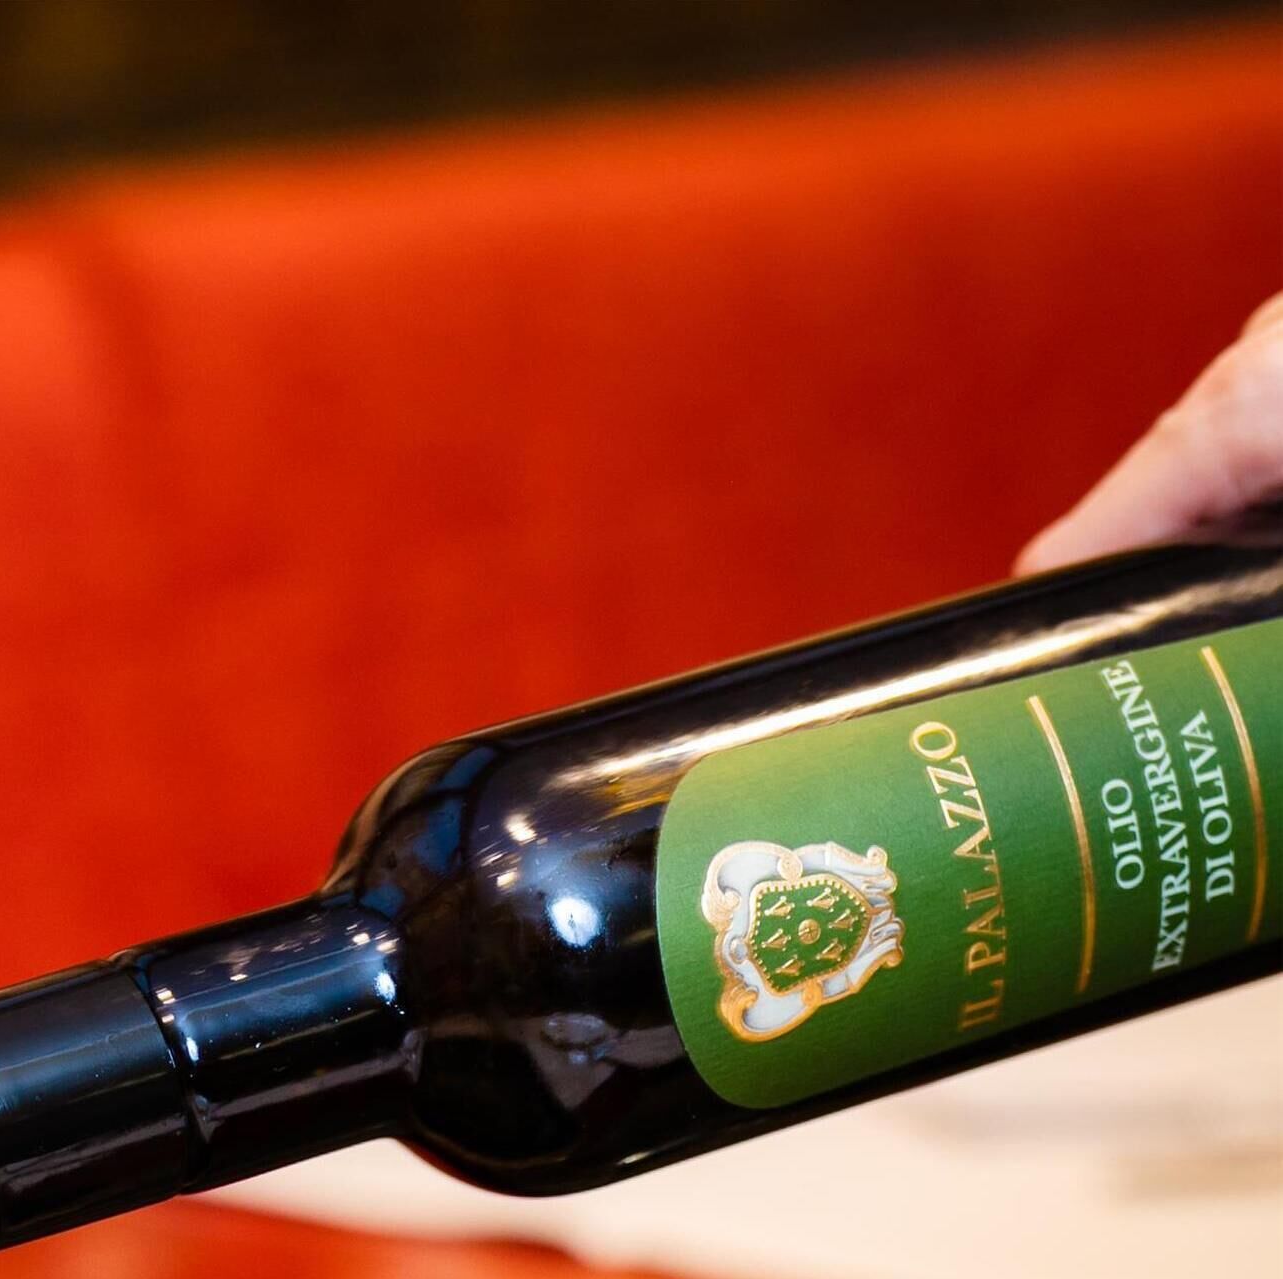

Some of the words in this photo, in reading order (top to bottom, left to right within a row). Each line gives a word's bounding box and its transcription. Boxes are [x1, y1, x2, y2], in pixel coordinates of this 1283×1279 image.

[1101, 660, 1190, 971] EXTRAVERGINE
[1102, 778, 1145, 890] OLIO
[1180, 710, 1232, 845] OLIVA
[911, 721, 1006, 974] PALAZZO
[1205, 850, 1235, 902] DI
[960, 978, 1004, 1031] IL
